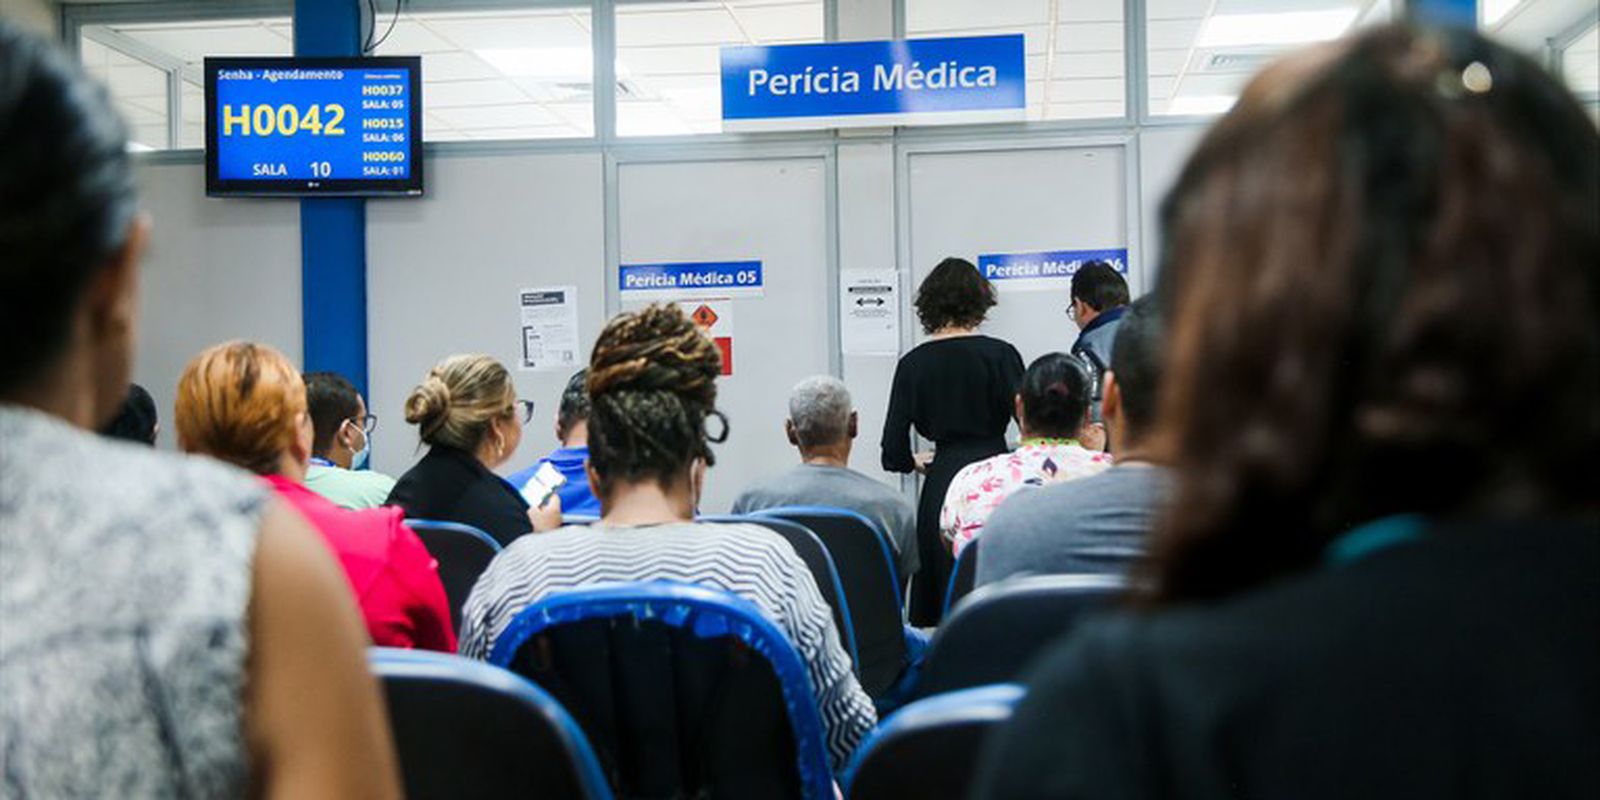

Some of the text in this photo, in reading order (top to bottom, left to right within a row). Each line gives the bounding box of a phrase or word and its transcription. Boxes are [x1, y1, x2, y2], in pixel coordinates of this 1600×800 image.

[218, 69, 253, 80] Senha
[262, 68, 344, 83] Agendamento
[747, 60, 998, 97] Perícia Médica
[362, 84, 404, 97] H0037
[223, 103, 346, 136] H0042
[362, 117, 405, 129] H0015
[253, 161, 332, 178] SALA 10
[1042, 260, 1083, 275] Médi
[680, 271, 734, 286] Médica
[736, 270, 757, 284] 05
